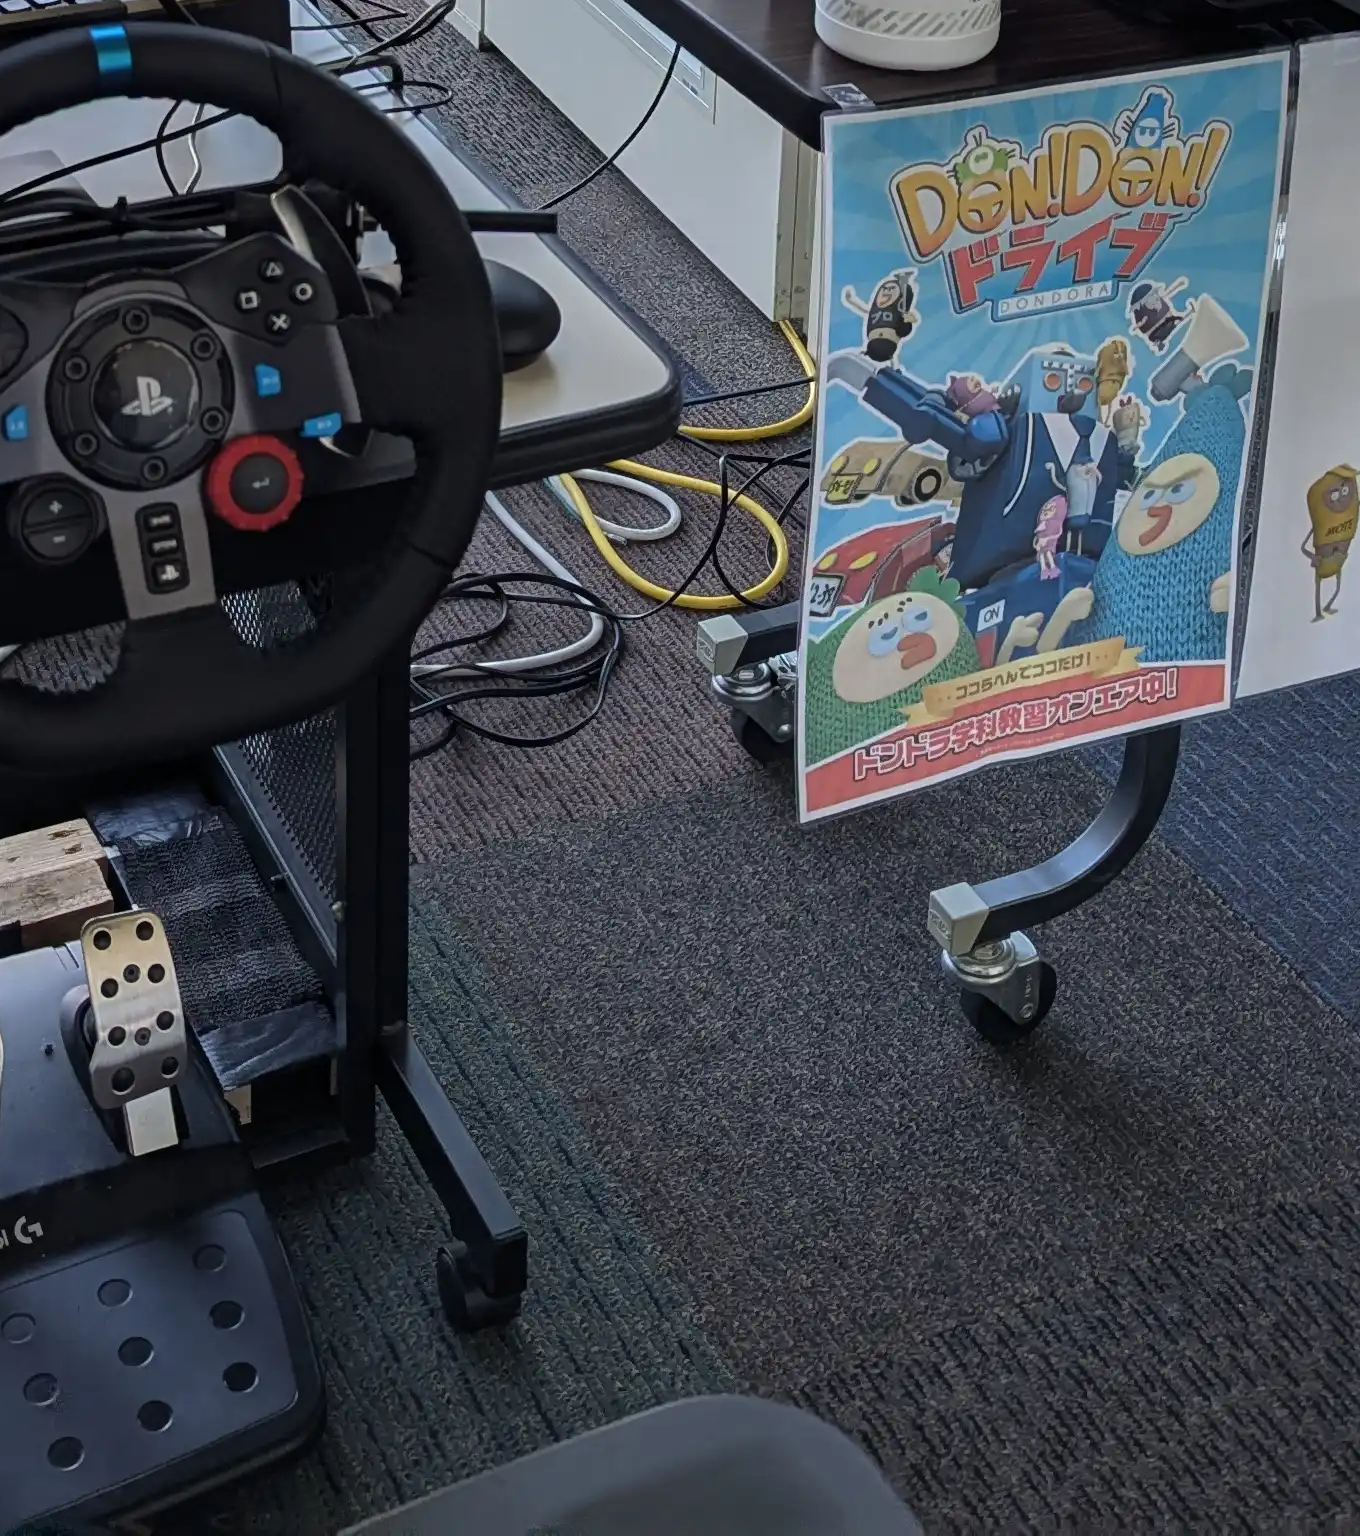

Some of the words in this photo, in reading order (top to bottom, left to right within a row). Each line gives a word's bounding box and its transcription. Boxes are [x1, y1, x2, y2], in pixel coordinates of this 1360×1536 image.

[948, 212, 1169, 309] ドライブ
[999, 283, 1110, 314] DONDORA
[983, 606, 1000, 624] ON
